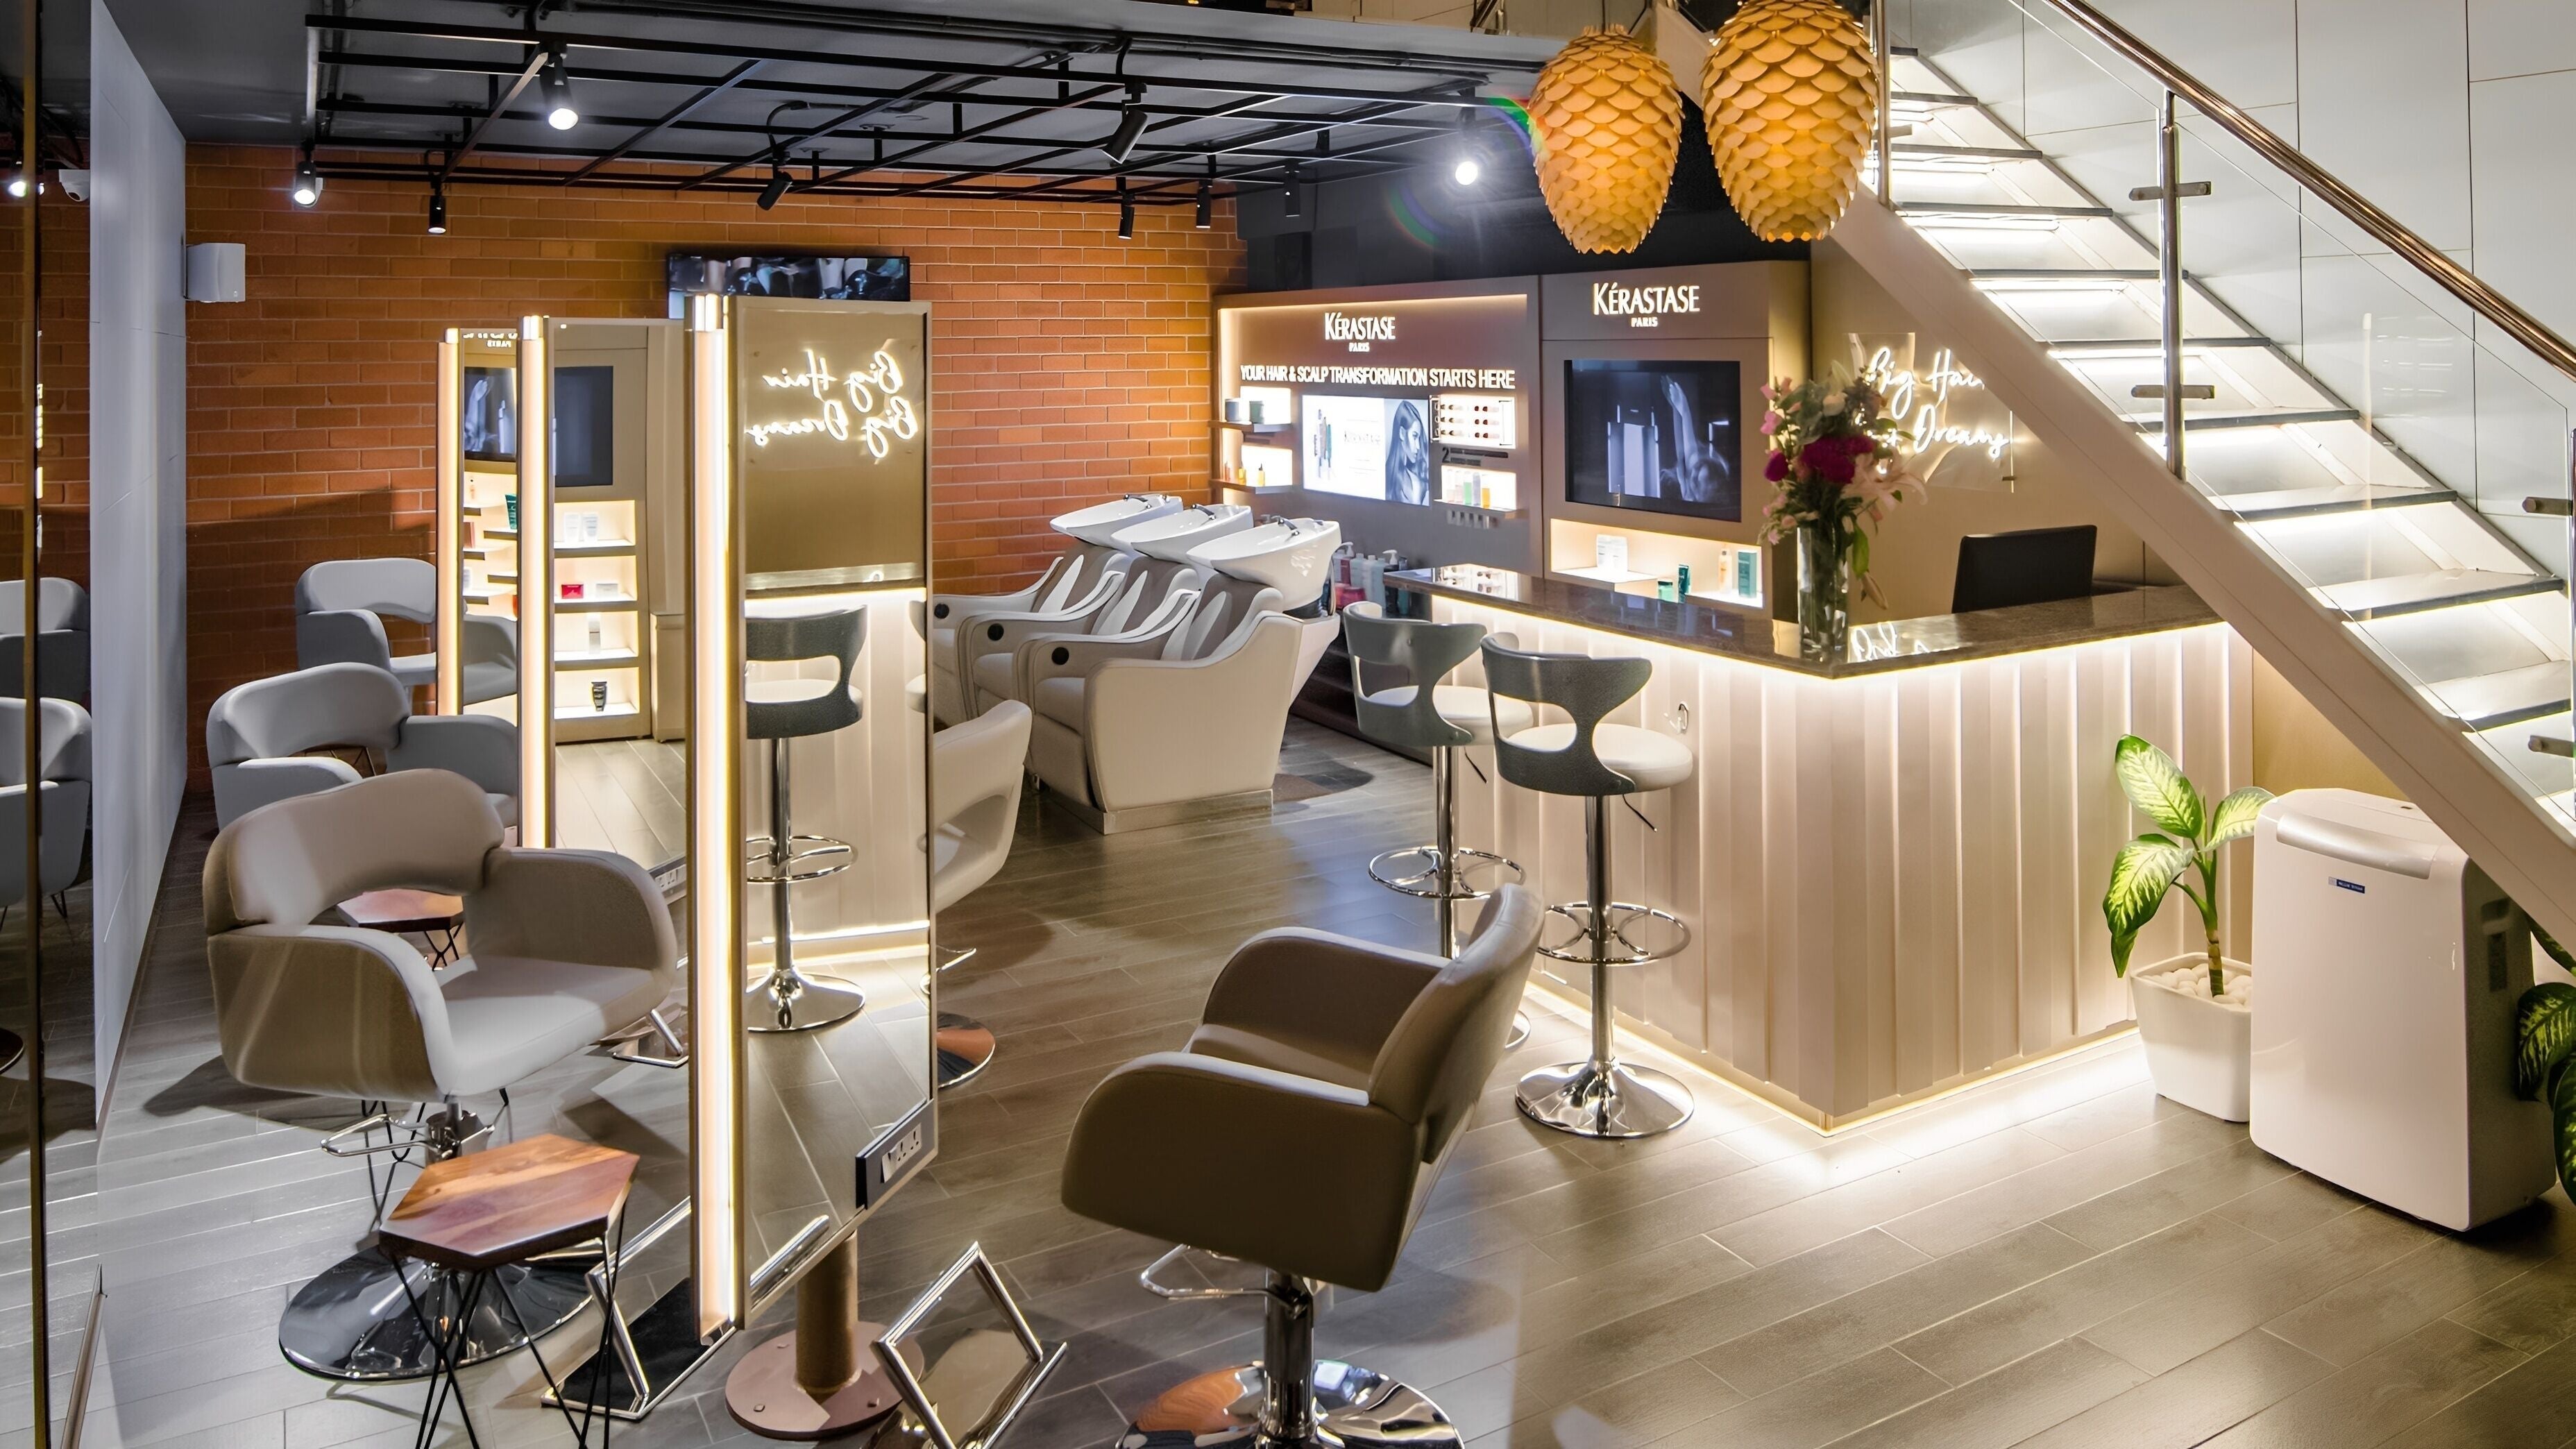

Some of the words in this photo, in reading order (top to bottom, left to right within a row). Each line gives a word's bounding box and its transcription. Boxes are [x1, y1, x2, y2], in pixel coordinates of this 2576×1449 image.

[1593, 282, 1700, 315] KÉRASTASE
[1324, 312, 1396, 340] KÉRASTASE
[1631, 317, 1658, 328] PARIS
[1348, 342, 1370, 352] PARIS
[1240, 365, 1265, 381] YOUR
[1266, 366, 1289, 382] HAIR
[1289, 366, 1296, 382] &
[1297, 366, 1328, 383] SCALP
[1329, 367, 1428, 387] TRANSFORMATION
[1430, 368, 1476, 388] STARTS
[1479, 369, 1516, 389] HERE
